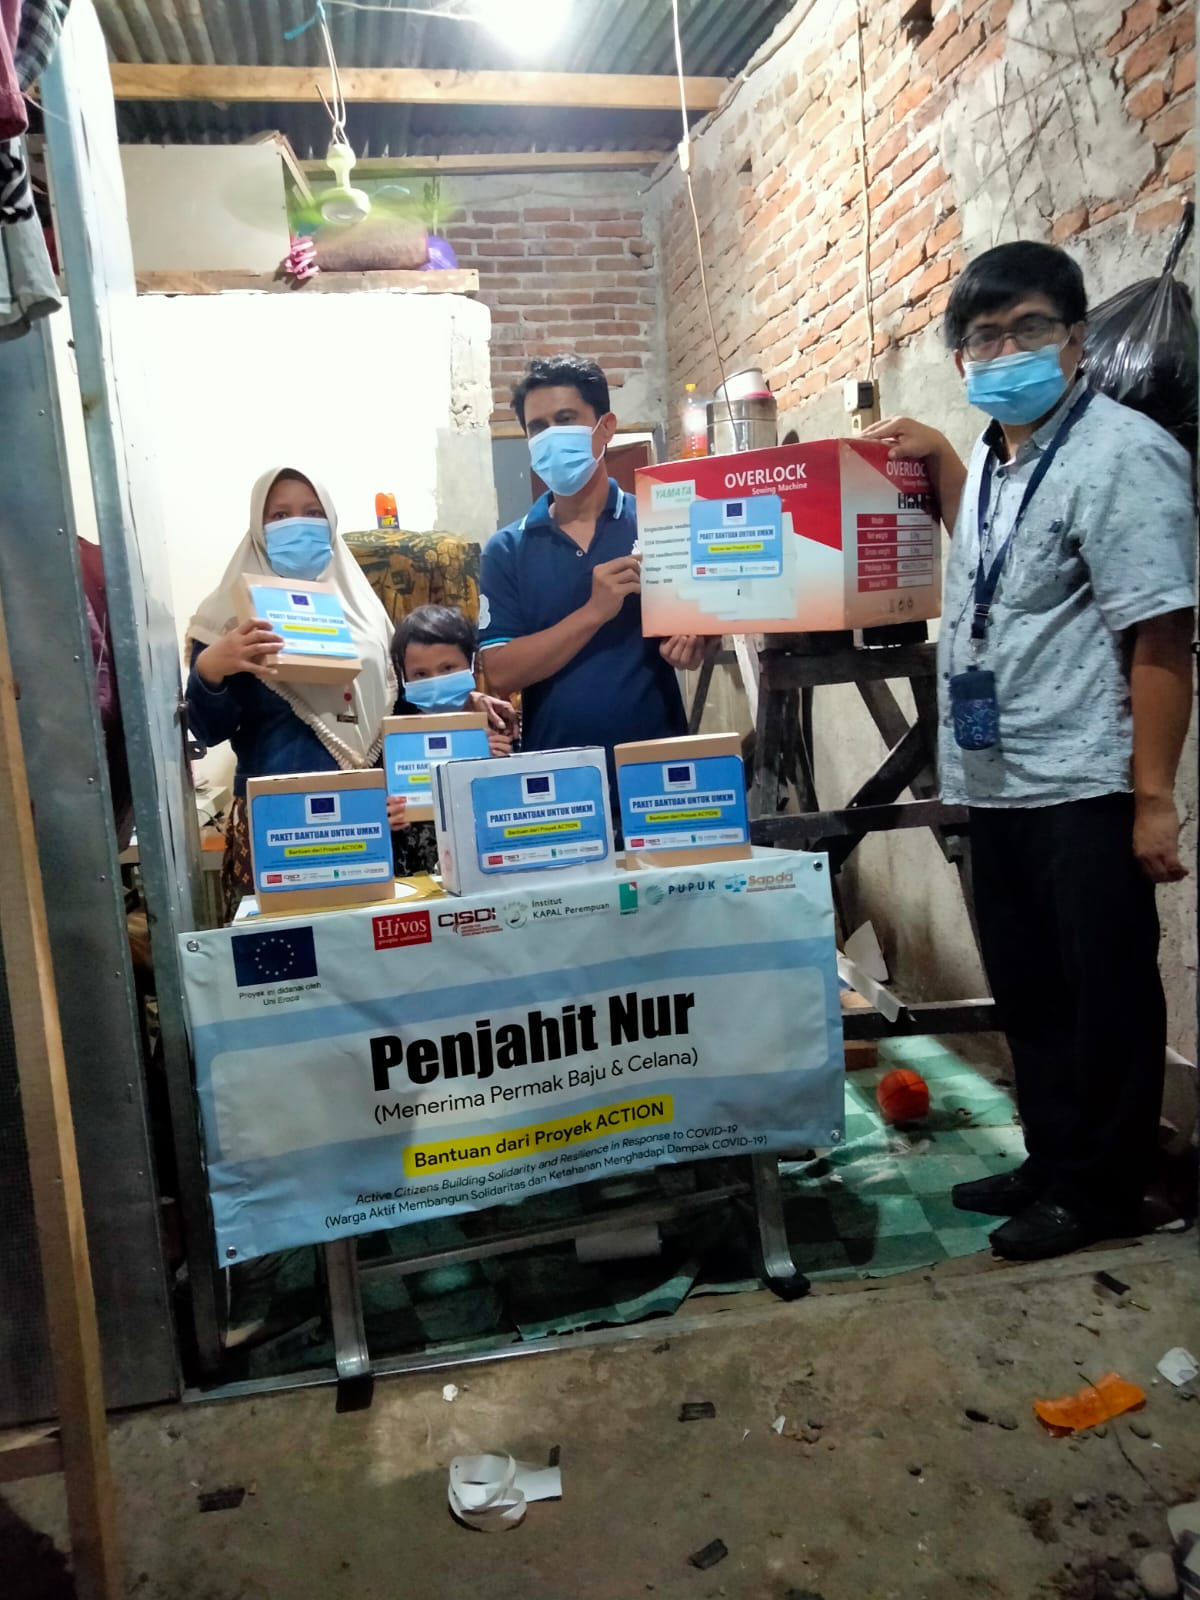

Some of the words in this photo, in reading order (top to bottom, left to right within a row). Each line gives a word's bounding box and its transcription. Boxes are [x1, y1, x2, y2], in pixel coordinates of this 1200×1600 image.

[724, 463, 807, 488] OVERLOCK
[886, 461, 926, 477] OVERLOC
[655, 486, 692, 498] YAMATA
[751, 486, 776, 495] Sewing
[778, 482, 807, 492] Machine
[632, 799, 653, 808] PAKET
[654, 797, 686, 807] BANTUAN
[687, 795, 710, 804] UNTUK
[711, 793, 733, 802] UMKM
[490, 813, 511, 823] PAKET
[513, 810, 545, 821] BANTUAN
[546, 806, 569, 817] UNTUK
[571, 804, 592, 814] UMKM
[270, 832, 293, 842] PAKET
[294, 829, 329, 840] BANTUAN
[330, 827, 354, 838] UNTUK
[356, 826, 380, 836] UMKM
[668, 880, 715, 894] PUPUK
[531, 898, 562, 908] Institut
[533, 909, 562, 919] KAPAL
[565, 903, 610, 915] Perempuan
[377, 917, 427, 938] Hivos
[239, 991, 264, 1000] Proyek
[277, 985, 304, 994] didanai
[305, 982, 322, 990] oleh
[263, 997, 276, 1006] Uni
[277, 995, 300, 1004] Eropa
[370, 1004, 598, 1091] Penjahit
[608, 992, 695, 1046] Nur
[374, 1094, 485, 1124] (Menerima
[490, 1074, 564, 1103] Permak
[568, 1065, 606, 1087] Baju
[611, 1059, 623, 1075] &
[628, 1048, 698, 1071] Celana)
[414, 1143, 491, 1168] Bantuan
[496, 1133, 530, 1154] dari
[535, 1119, 592, 1145] Proyek
[596, 1101, 664, 1129] ACTION
[355, 1191, 392, 1206] Active
[394, 1183, 439, 1198] Citizens
[442, 1175, 486, 1189] Building
[487, 1163, 536, 1182] Solidarity
[538, 1156, 558, 1169] and
[560, 1144, 609, 1163] Resilience
[611, 1141, 620, 1151] in
[622, 1132, 670, 1148] Response
[673, 1131, 684, 1140] to
[686, 1124, 738, 1138] COVID-19
[325, 1212, 367, 1229] (Warga
[369, 1204, 396, 1218] Aktif
[399, 1193, 469, 1213] Membangun
[471, 1180, 526, 1200] Solidaritas
[528, 1174, 547, 1187] dan
[549, 1161, 602, 1180] Ketahanan
[604, 1146, 665, 1167] Menghadapi
[667, 1142, 710, 1155] Dampak
